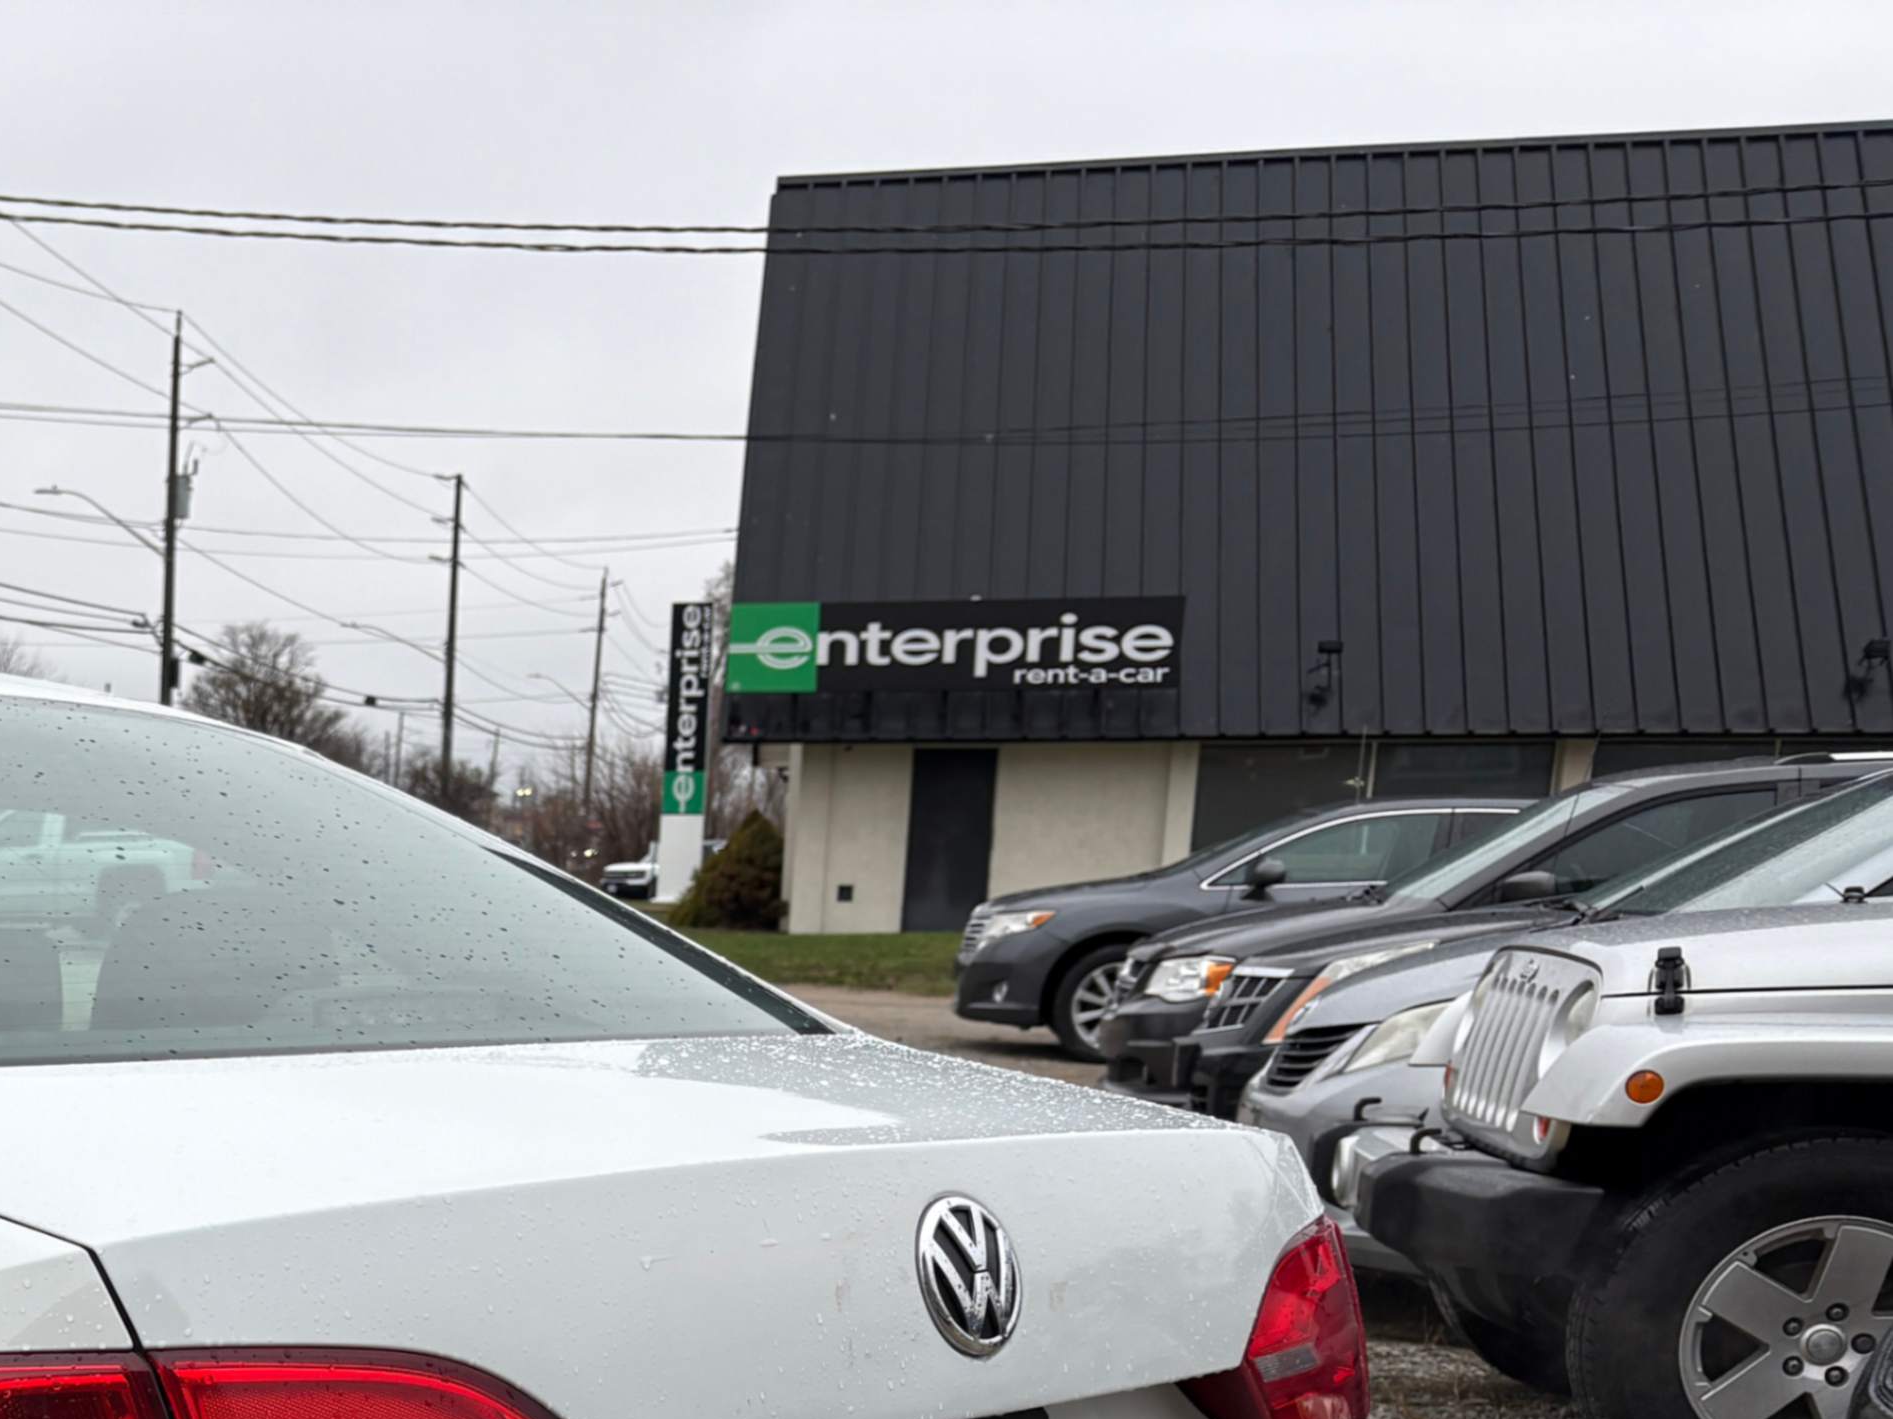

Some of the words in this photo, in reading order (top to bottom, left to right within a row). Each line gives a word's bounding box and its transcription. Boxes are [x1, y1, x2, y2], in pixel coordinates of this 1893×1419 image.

[728, 613, 1174, 678] enterprise
[1012, 664, 1171, 685] rent-a-car
[670, 604, 705, 813] enterprise
